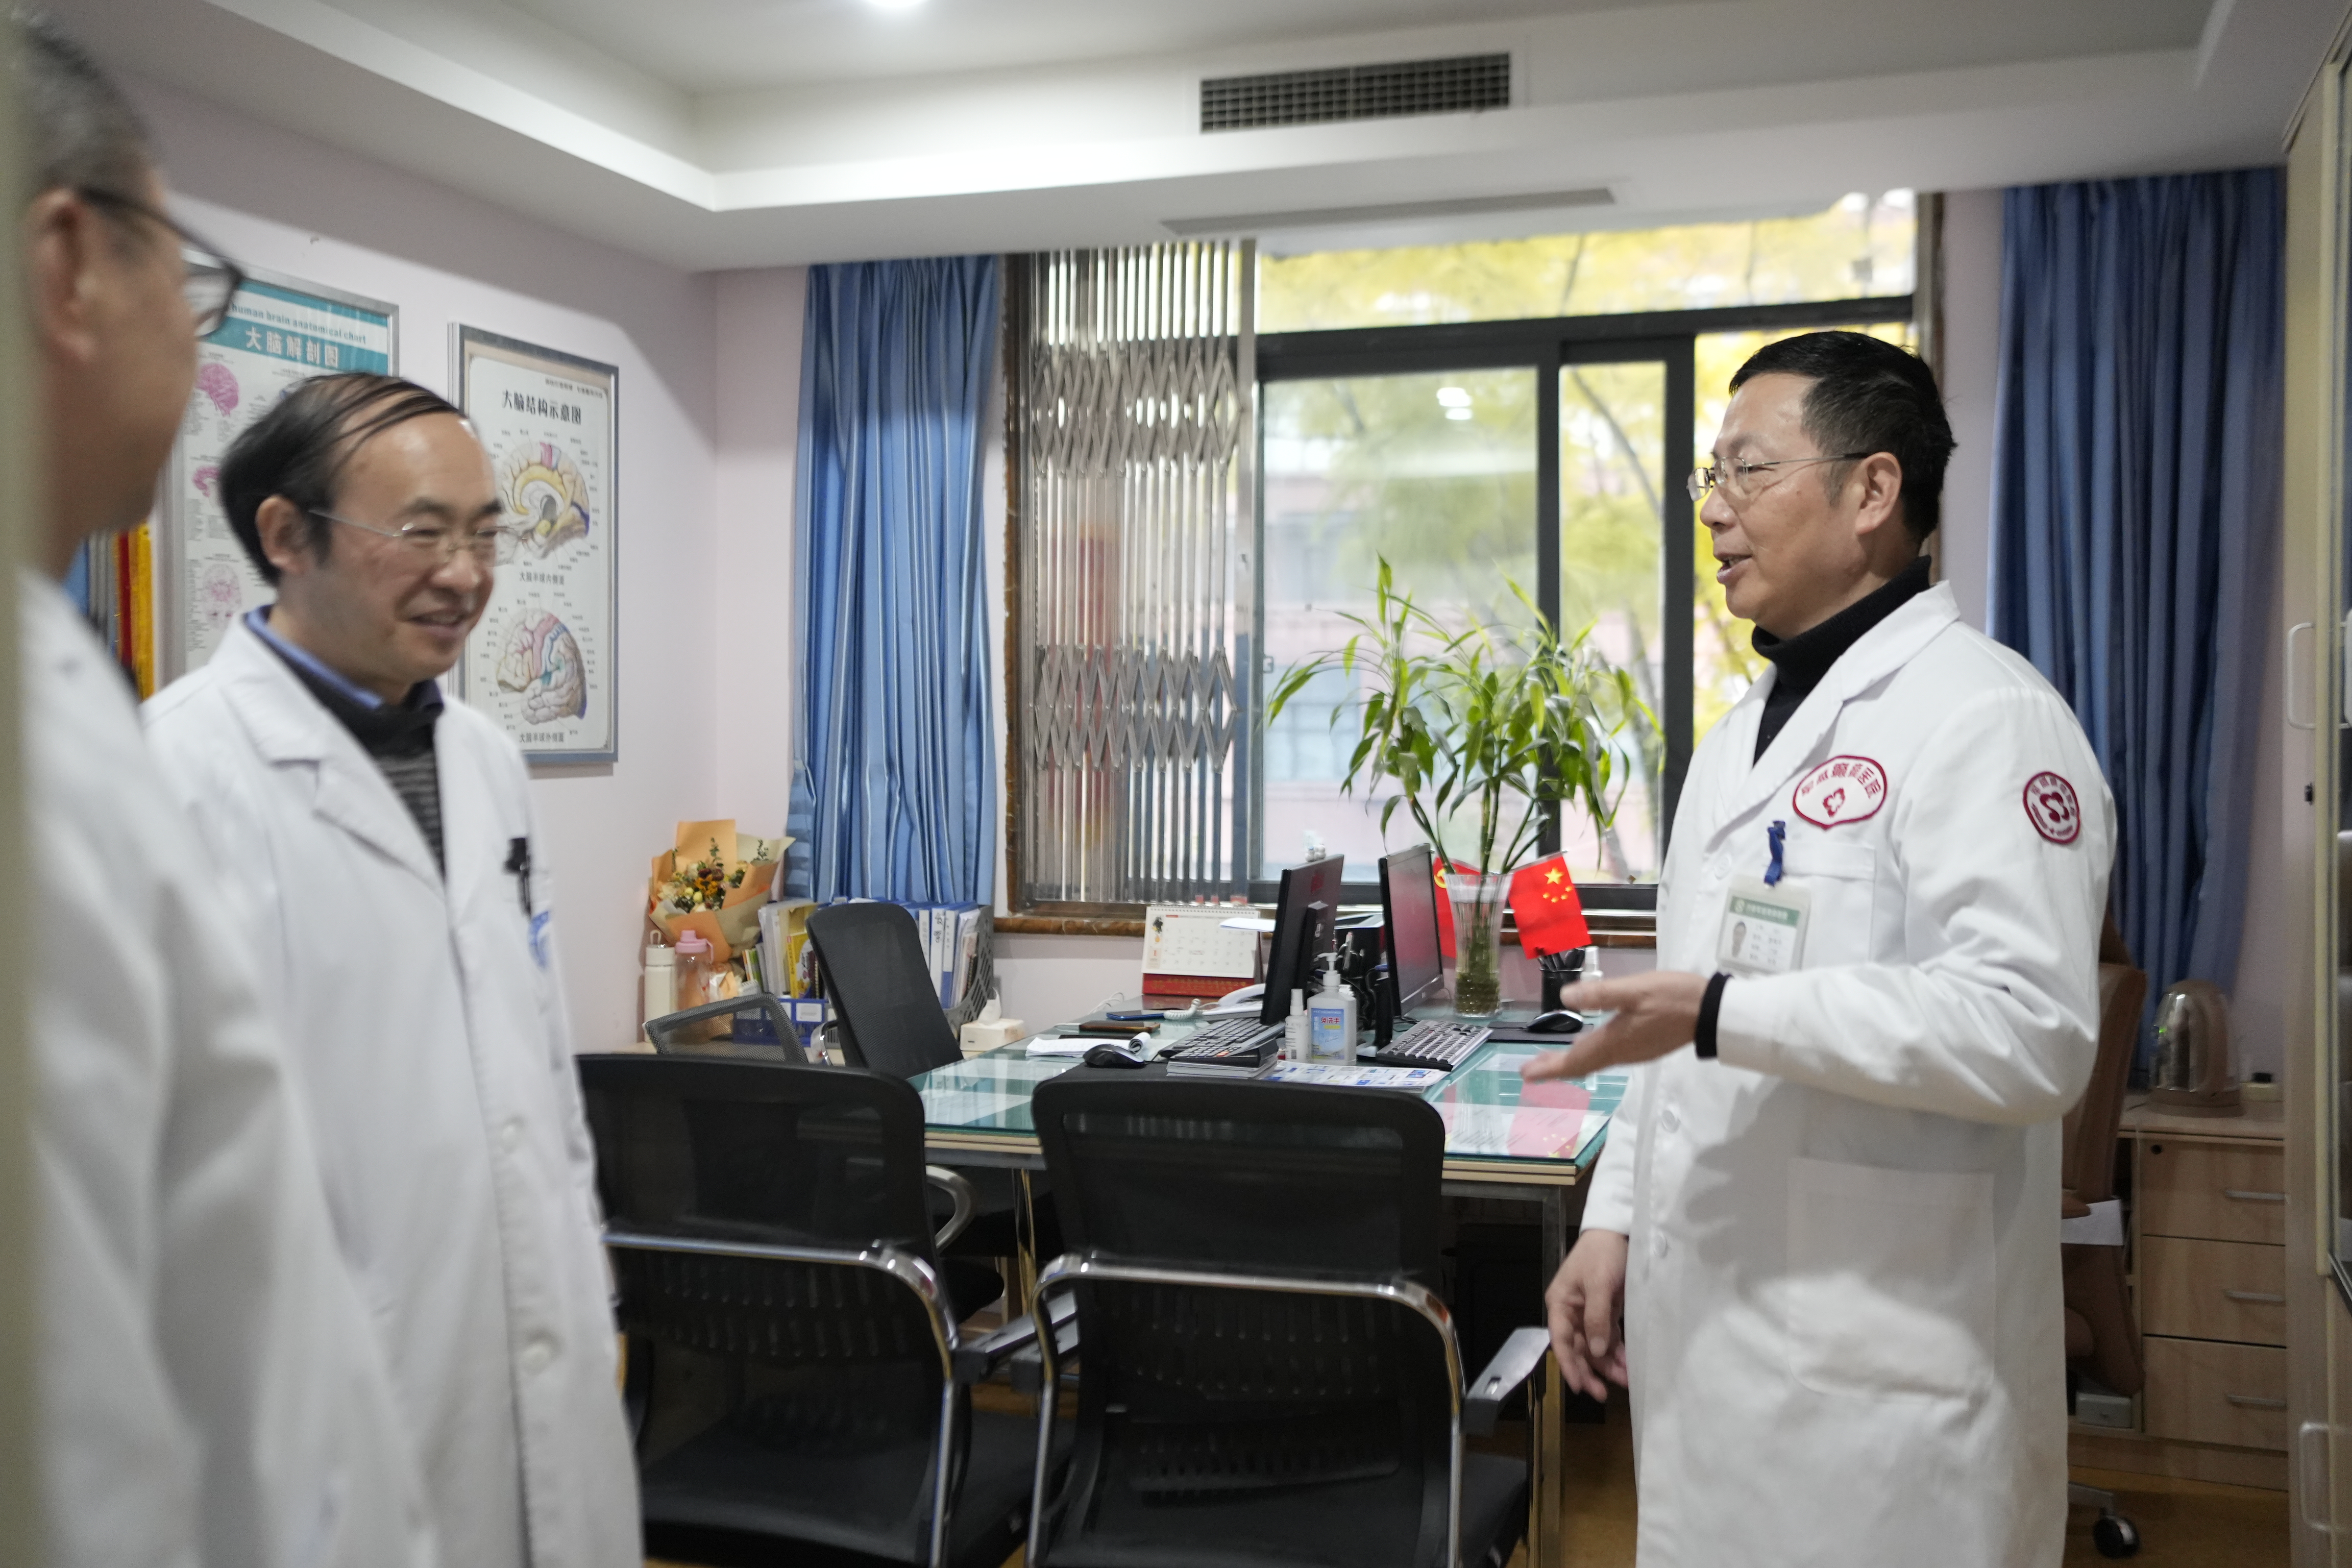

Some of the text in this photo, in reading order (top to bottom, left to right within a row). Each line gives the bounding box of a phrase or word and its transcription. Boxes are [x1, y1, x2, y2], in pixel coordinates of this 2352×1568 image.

[266, 311, 290, 325] brain
[292, 320, 341, 338] anatomical
[344, 330, 366, 345] chart
[502, 389, 581, 425] 大脑结构示意图
